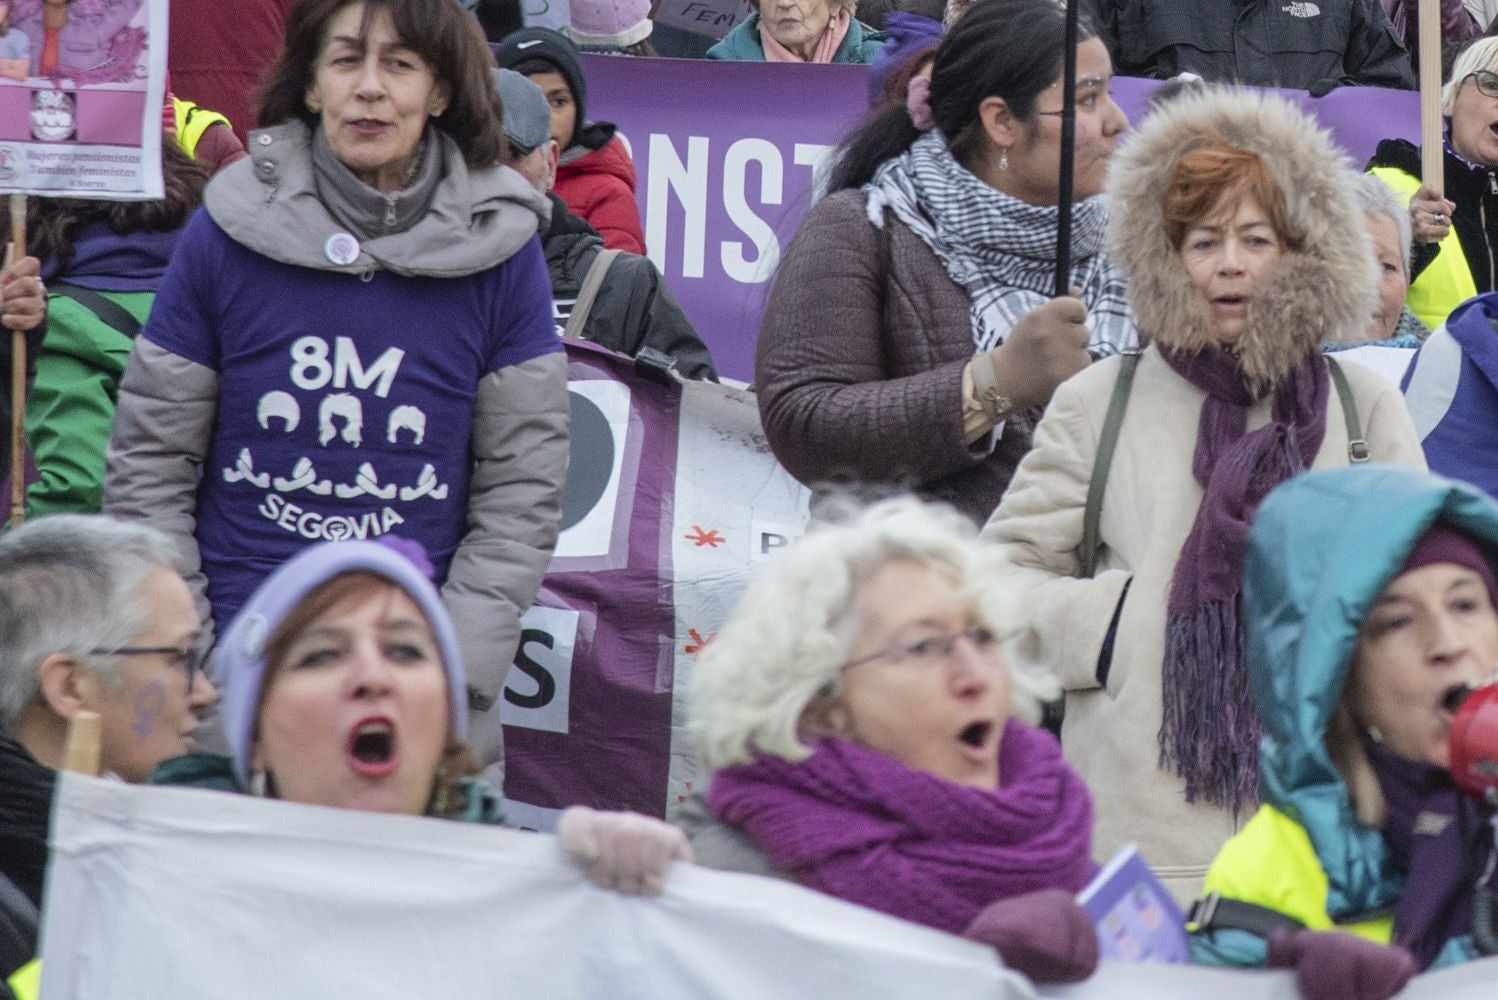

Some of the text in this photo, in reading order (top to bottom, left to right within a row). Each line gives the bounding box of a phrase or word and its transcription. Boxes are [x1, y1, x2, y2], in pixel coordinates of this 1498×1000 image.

[289, 336, 406, 398] 8M
[258, 493, 405, 541] SEGOVIA
[503, 628, 556, 709] S
